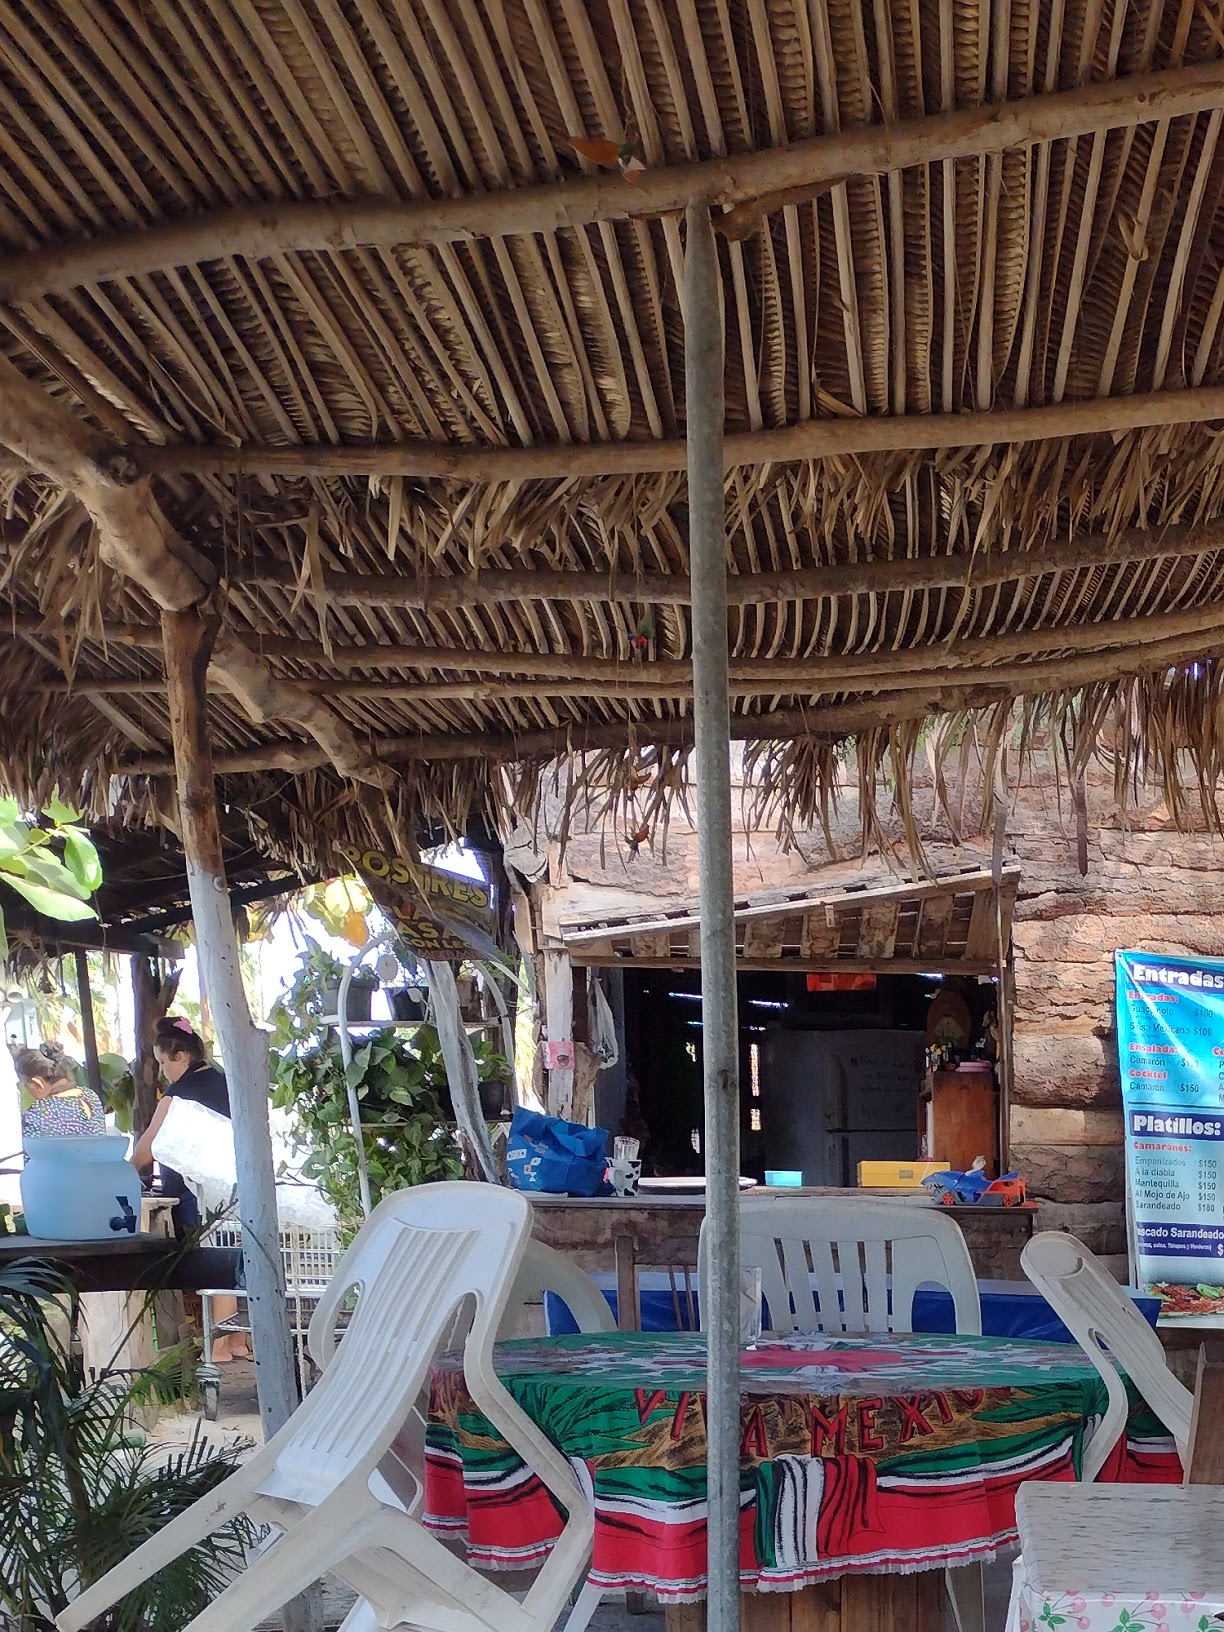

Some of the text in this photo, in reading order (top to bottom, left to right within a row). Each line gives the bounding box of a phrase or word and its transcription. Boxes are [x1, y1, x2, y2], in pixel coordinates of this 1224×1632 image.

[347, 845, 488, 908] POSTRES
[442, 939, 473, 949] LEC
[1128, 990, 1178, 1003] Enradas:
[1130, 1004, 1213, 1018] Guacole $100
[1194, 1026, 1212, 1036] $100
[1130, 1056, 1199, 1068] Camarón $10
[1134, 1115, 1221, 1136] Platillos:
[1133, 1141, 1192, 1152] Camarones:
[1135, 1156, 1217, 1168] Empanizados $150
[1135, 1168, 1217, 1180] A la diabla $150
[1135, 1179, 1216, 1190] Mantequilla $150
[1135, 1190, 1216, 1201] Al Mojo de Ajo $150
[1135, 1201, 1215, 1213] Sarandeado $180
[1137, 1227, 1168, 1237] scado
[1171, 1228, 1224, 1240] Sarandeado
[634, 1386, 1012, 1458] VIA MEXIC
